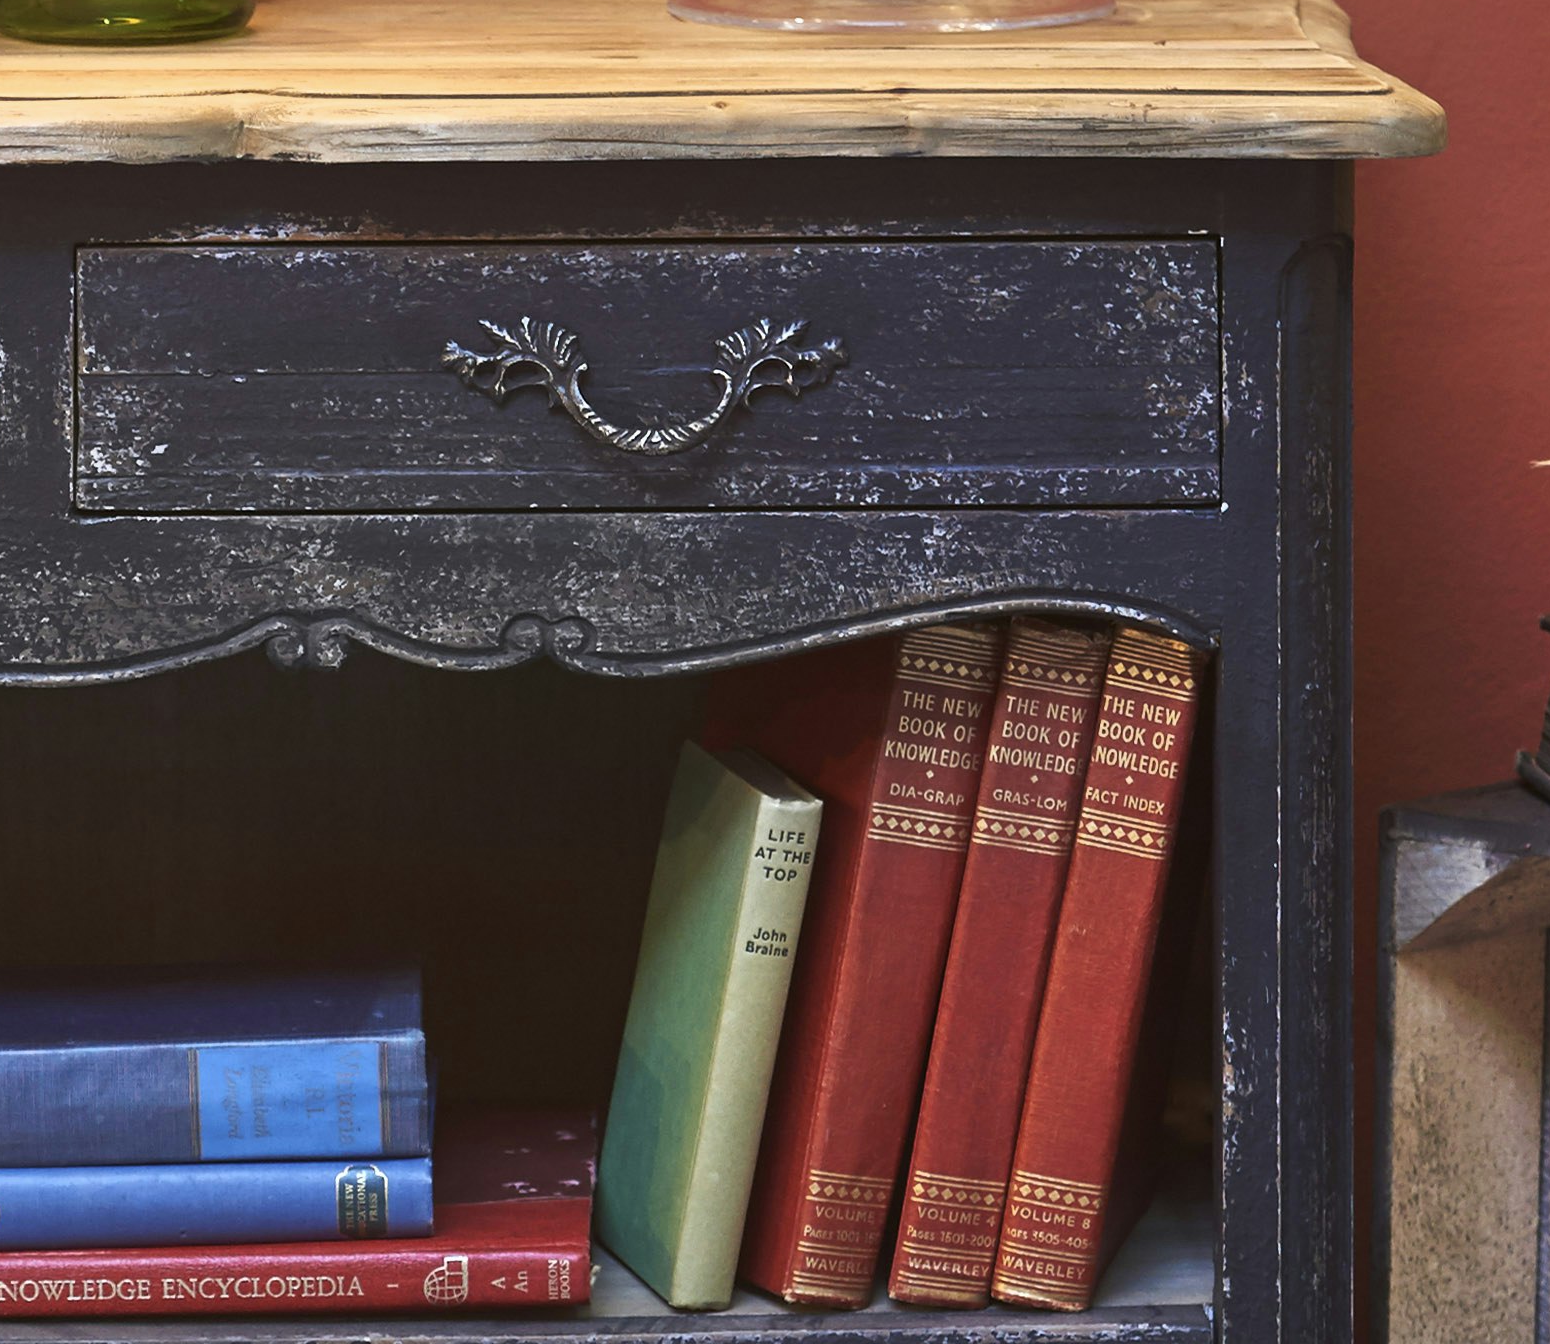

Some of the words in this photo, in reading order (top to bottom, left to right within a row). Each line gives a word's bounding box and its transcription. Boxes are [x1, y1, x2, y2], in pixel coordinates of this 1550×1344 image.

[902, 690, 936, 712] THE
[942, 695, 983, 719] NEW
[1005, 694, 1039, 717] THE
[1046, 703, 1087, 725] NEW
[1101, 694, 1135, 718] THE
[1142, 702, 1182, 727] NEW
[898, 715, 946, 740] BOOK
[953, 724, 977, 744] OF
[1001, 720, 1050, 745] BOOK
[1058, 730, 1082, 750] OF
[1098, 719, 1146, 747] BOOK
[1152, 731, 1175, 752] OF
[885, 740, 980, 772] KNOWLEDGE
[989, 744, 1084, 777] KNOWLEDGE
[889, 782, 965, 807] DIA-GRAP
[992, 788, 1068, 812] GRAS-LOM
[1085, 785, 1119, 806] FACT
[1123, 794, 1166, 816] INDEX
[768, 828, 806, 844] LIFE
[755, 846, 777, 860] AT
[782, 849, 812, 864] THE
[763, 866, 798, 882] TOP
[745, 940, 789, 957] Braine
[753, 927, 788, 943] John
[368, 1192, 378, 1223] PRESS
[815, 1205, 876, 1225] VOLUME
[917, 1205, 980, 1227] VOLUME
[985, 1214, 997, 1228] 4
[1010, 1203, 1076, 1228] VOLUME
[1082, 1217, 1091, 1230] 8
[547, 1259, 558, 1301] HERON
[560, 1258, 571, 1300] BOOKS
[907, 1256, 991, 1278] WAVERLEY
[1002, 1254, 1086, 1281] WAVERLEY
[161, 1275, 365, 1301] ENCYCLOPEDIA
[491, 1276, 506, 1290] A
[513, 1269, 528, 1293] An
